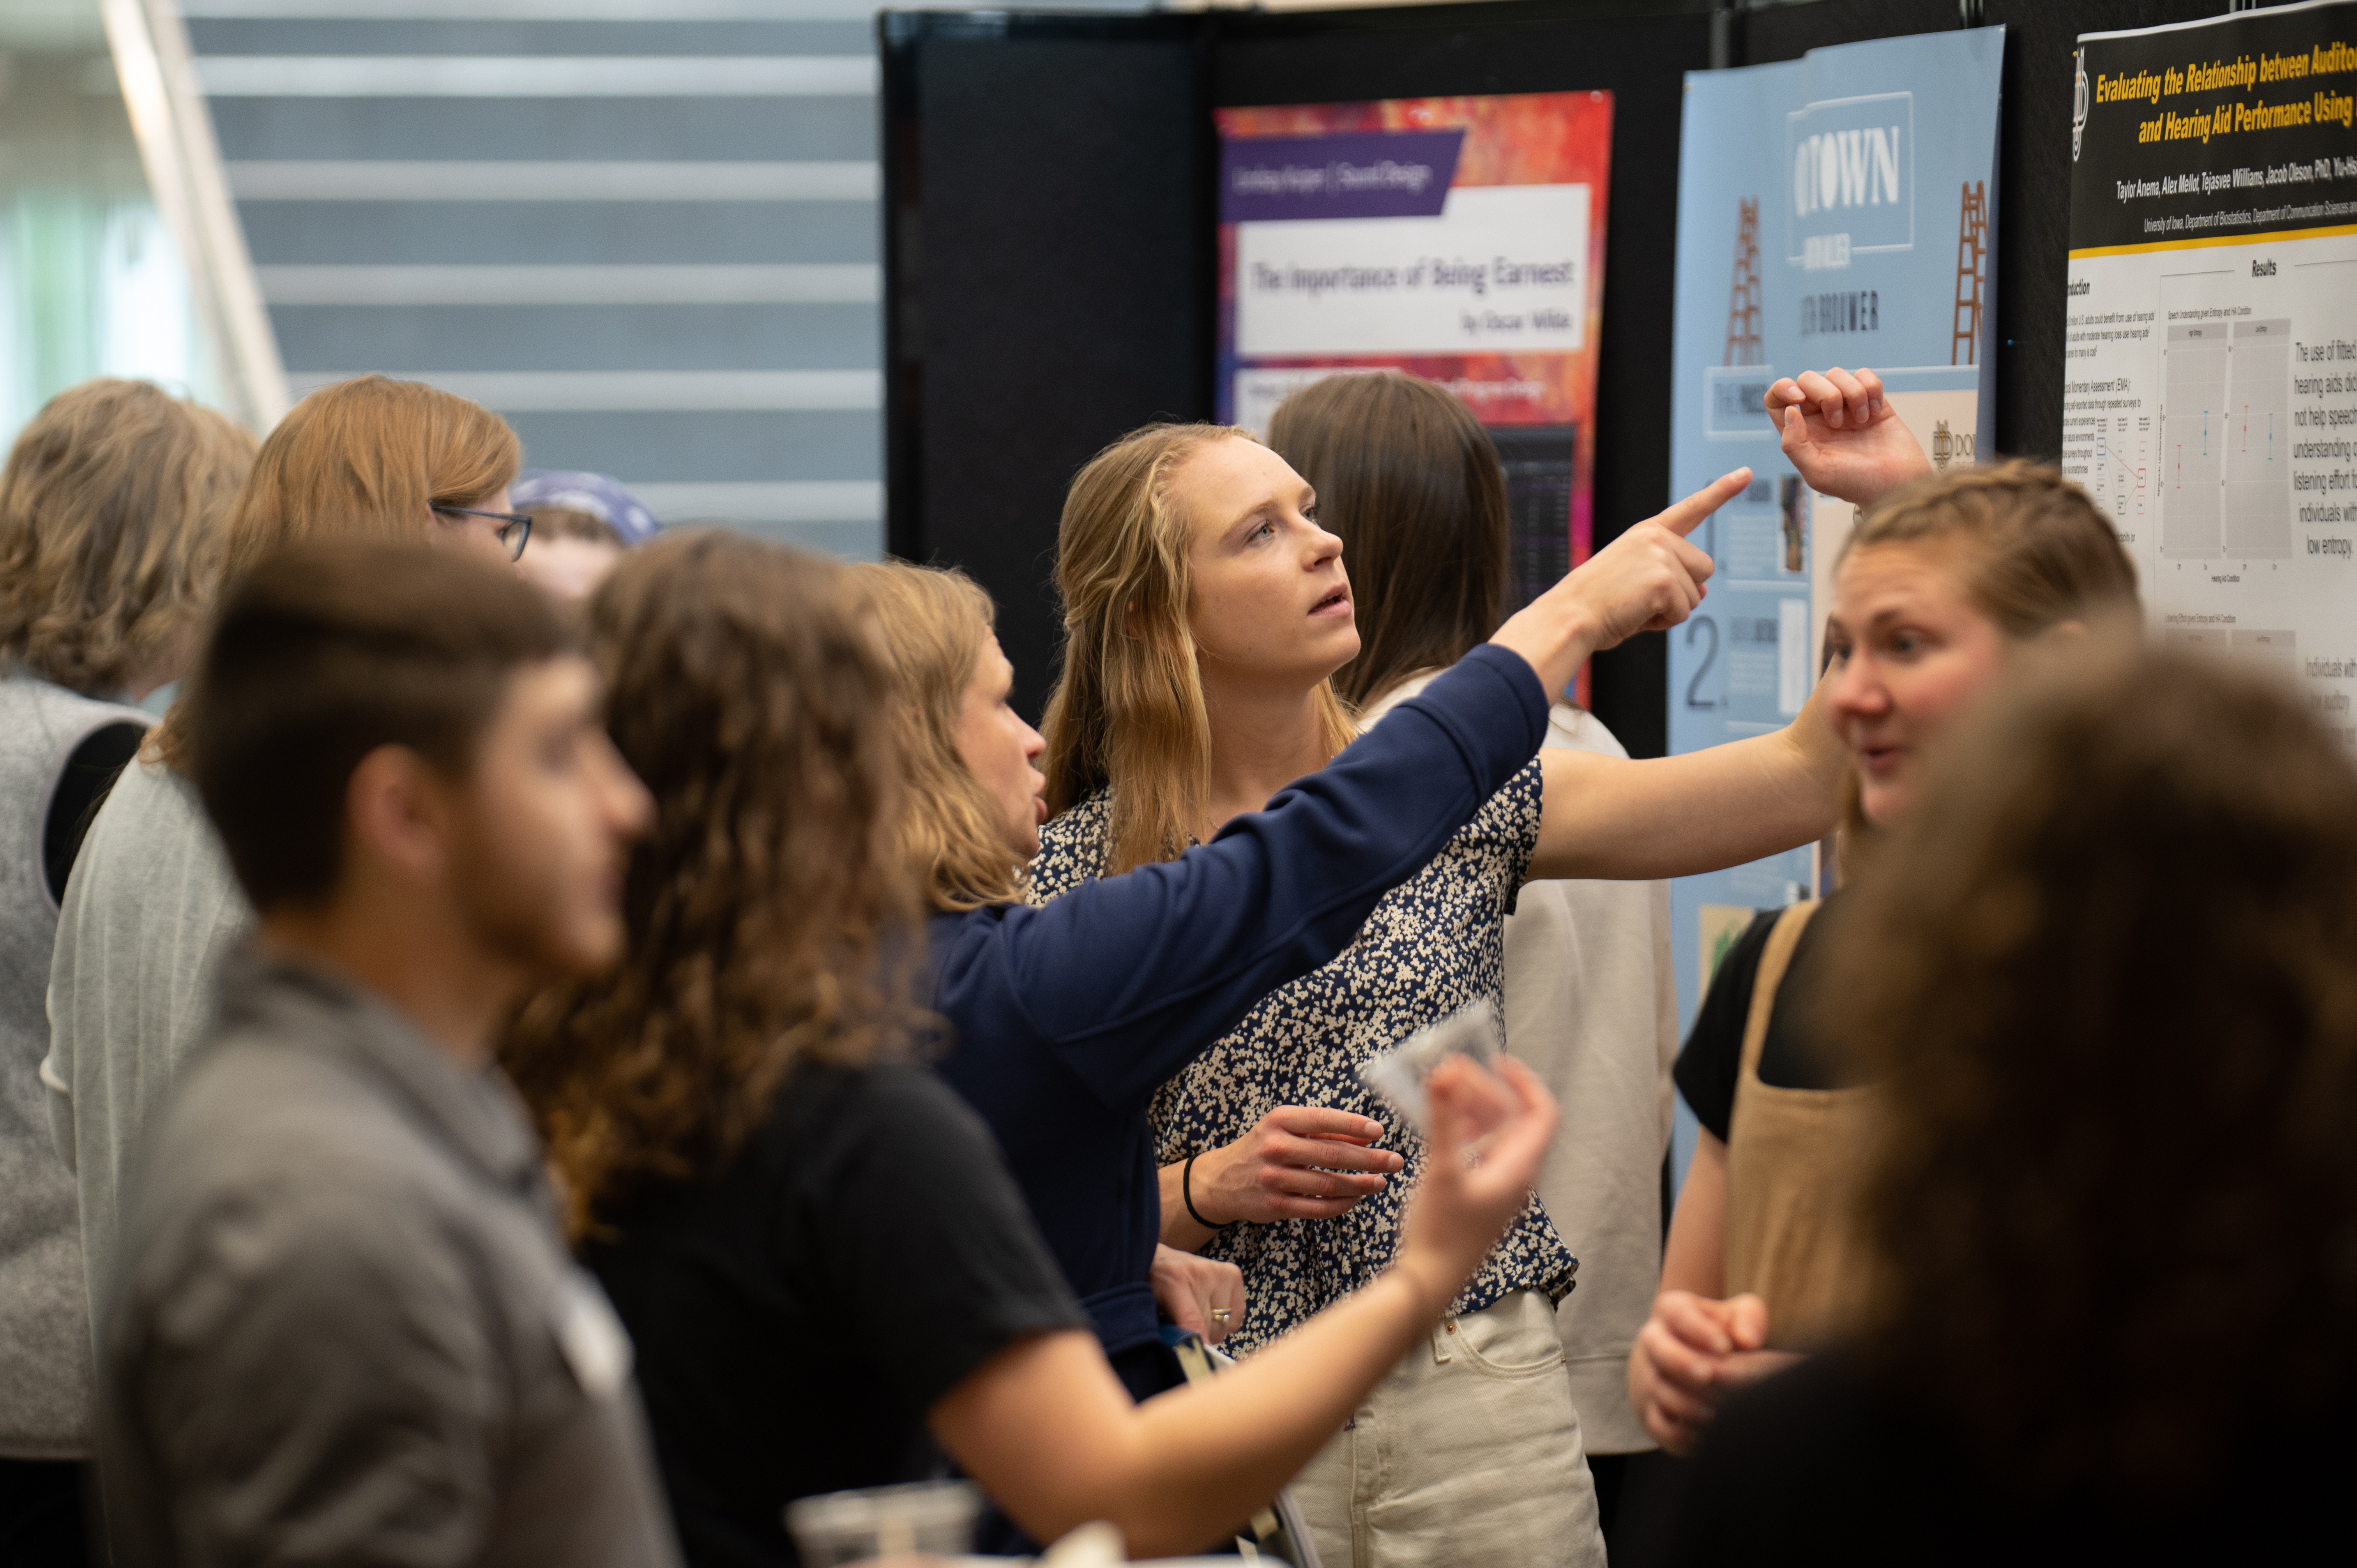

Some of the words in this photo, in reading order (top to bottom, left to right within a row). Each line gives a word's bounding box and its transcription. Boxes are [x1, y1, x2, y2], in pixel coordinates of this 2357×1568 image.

[2096, 69, 2161, 104] Evaluating
[2164, 67, 2183, 95] the
[2186, 55, 2257, 92] Relationship
[2260, 52, 2309, 82] between
[2139, 113, 2163, 143] and
[2165, 109, 2211, 144] Hearing
[2212, 104, 2232, 134] Aid
[2235, 100, 2312, 132] Performance
[2314, 90, 2354, 127] Using
[2117, 179, 2136, 204] Taylor
[2136, 178, 2161, 199] Anema,
[2161, 176, 2177, 194] Alex
[2202, 171, 2231, 195] Tejasvee
[2232, 168, 2264, 188] Williams,
[2265, 163, 2288, 185] Jacob
[2288, 162, 2313, 183] Oleson,
[2144, 217, 2166, 235] University
[2166, 215, 2172, 230] of
[2172, 215, 2184, 231] Iowa,
[2185, 213, 2213, 231] Department
[2214, 212, 2220, 226] of
[2220, 208, 2252, 226] Biostatistics,
[2252, 258, 2277, 277] Results
[2104, 312, 2115, 323] benefit
[2116, 312, 2125, 323] from
[2137, 311, 2148, 323] hearing
[2168, 311, 2179, 321] Speech
[2180, 309, 2200, 320] Understanding
[2210, 307, 2223, 318] Entropy
[2101, 329, 2114, 342] hearing
[2130, 328, 2142, 341] hearing
[2296, 342, 2309, 362] The
[2310, 346, 2325, 361] use
[2326, 340, 2334, 361] of
[2072, 380, 2090, 395] Momentary
[2091, 379, 2115, 392] Assessment
[2116, 378, 2131, 394] (EMA):
[2295, 373, 2323, 398] hearing
[2325, 372, 2343, 393] aids
[2095, 398, 2106, 411] through
[2107, 397, 2122, 410] repeated
[2123, 399, 2137, 410] surveys
[2137, 397, 2141, 408] to
[2079, 415, 2096, 427] experiences
[2295, 406, 2308, 426] not
[2308, 405, 2327, 431] help
[2076, 431, 2095, 441] environments
[2294, 437, 2351, 462] understanding
[2294, 470, 2327, 495] listening
[2329, 468, 2351, 489] effort
[2299, 501, 2341, 522] individuals
[2306, 534, 2320, 554] low
